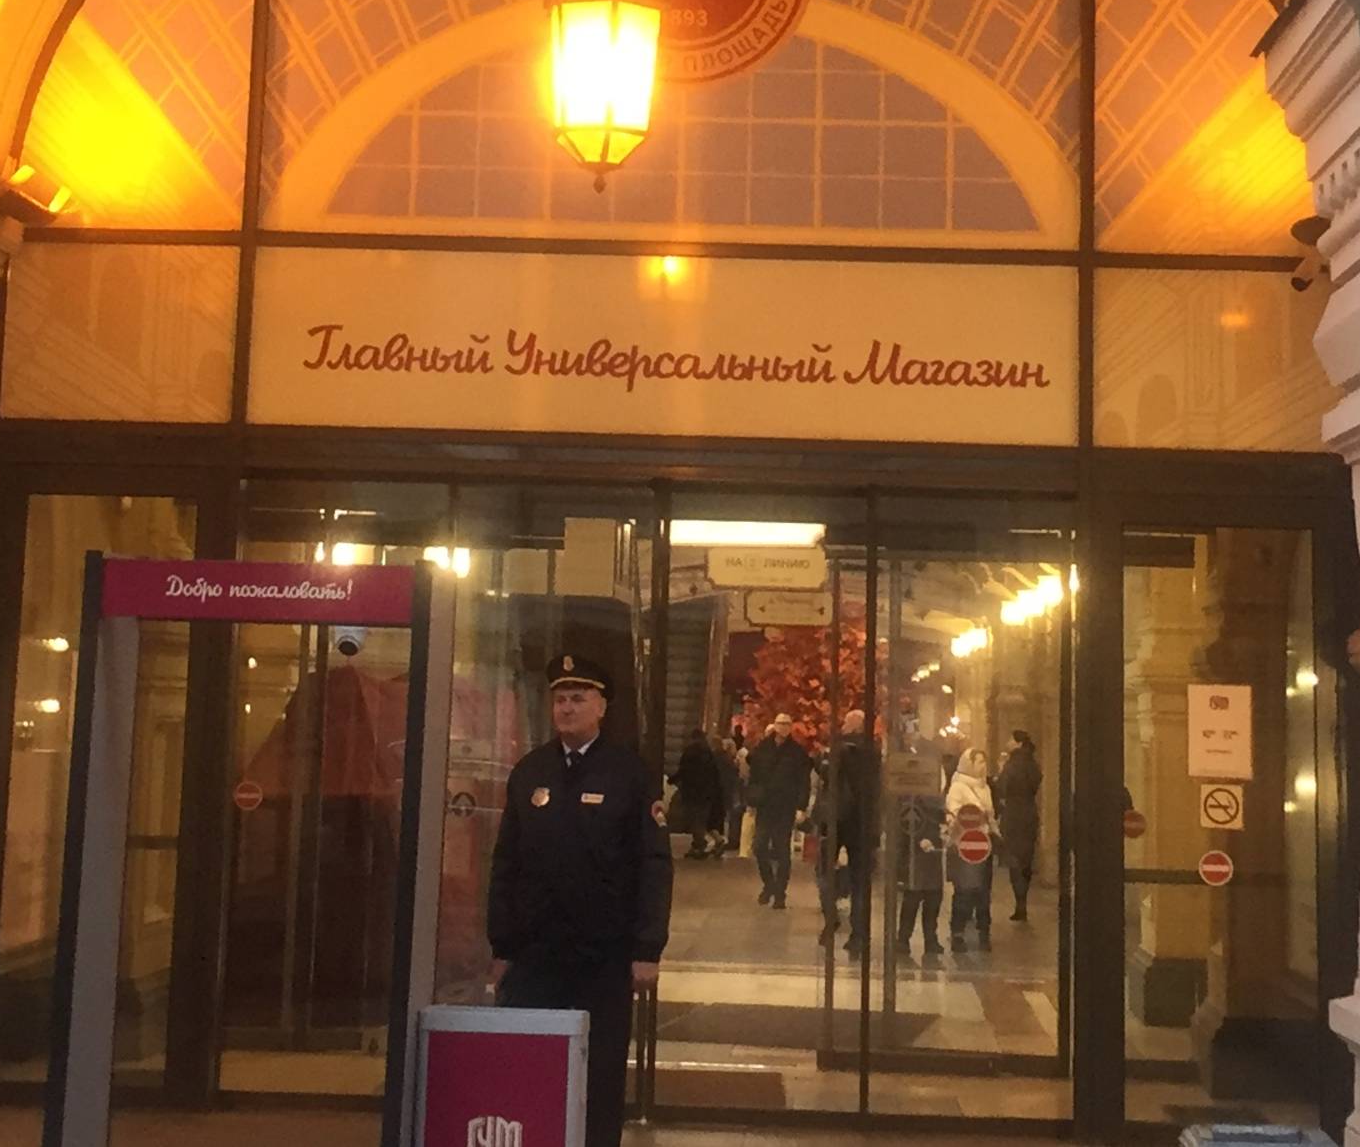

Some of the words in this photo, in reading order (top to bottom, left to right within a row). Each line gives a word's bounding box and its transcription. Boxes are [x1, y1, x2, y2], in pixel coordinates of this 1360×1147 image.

[670, 8, 709, 28] 893
[683, 0, 789, 73] ПЛОЩАДЬ
[302, 323, 495, 375] Главный
[504, 327, 837, 393] Универсальный
[842, 338, 1052, 389] Магазин
[165, 574, 223, 603] Добро
[228, 578, 355, 601] пожаловать!
